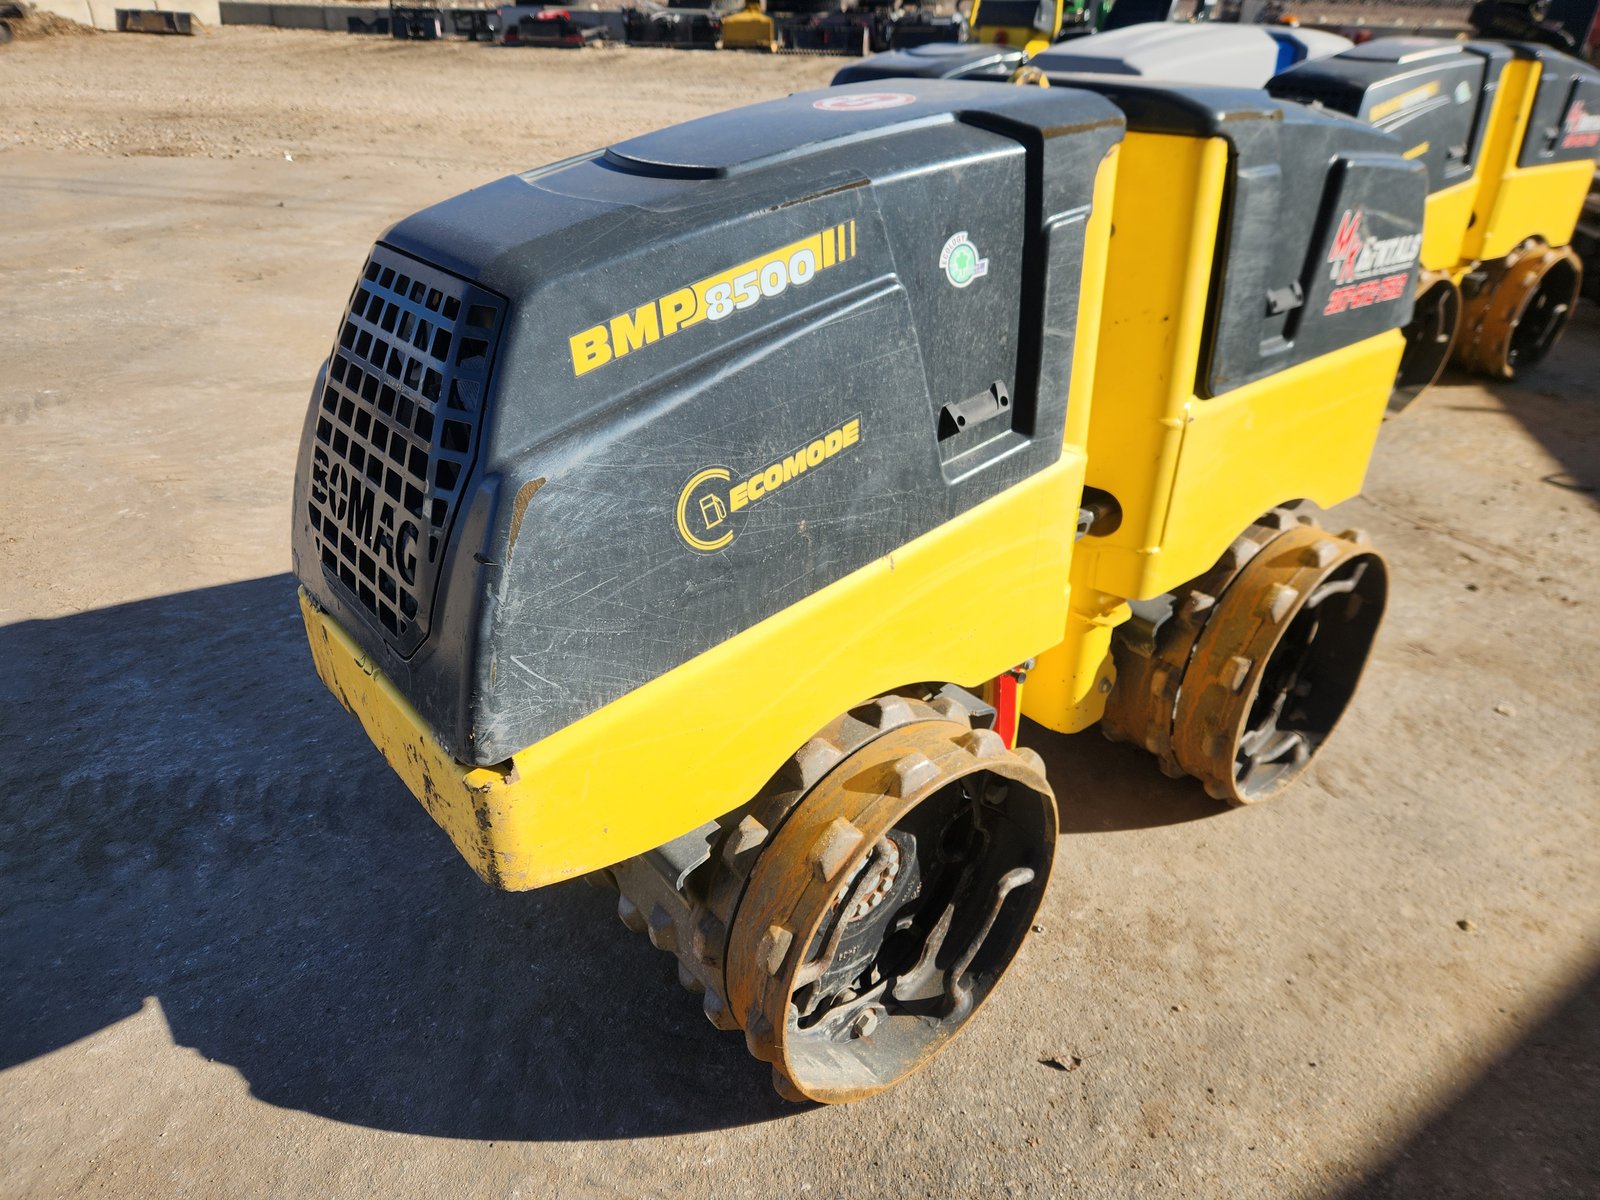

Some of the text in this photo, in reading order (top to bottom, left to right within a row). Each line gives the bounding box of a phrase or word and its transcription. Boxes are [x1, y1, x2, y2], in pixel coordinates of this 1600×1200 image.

[569, 248, 817, 377] BMP 8500
[312, 446, 420, 587] BOMAG
[729, 418, 860, 513] ECOMODE
